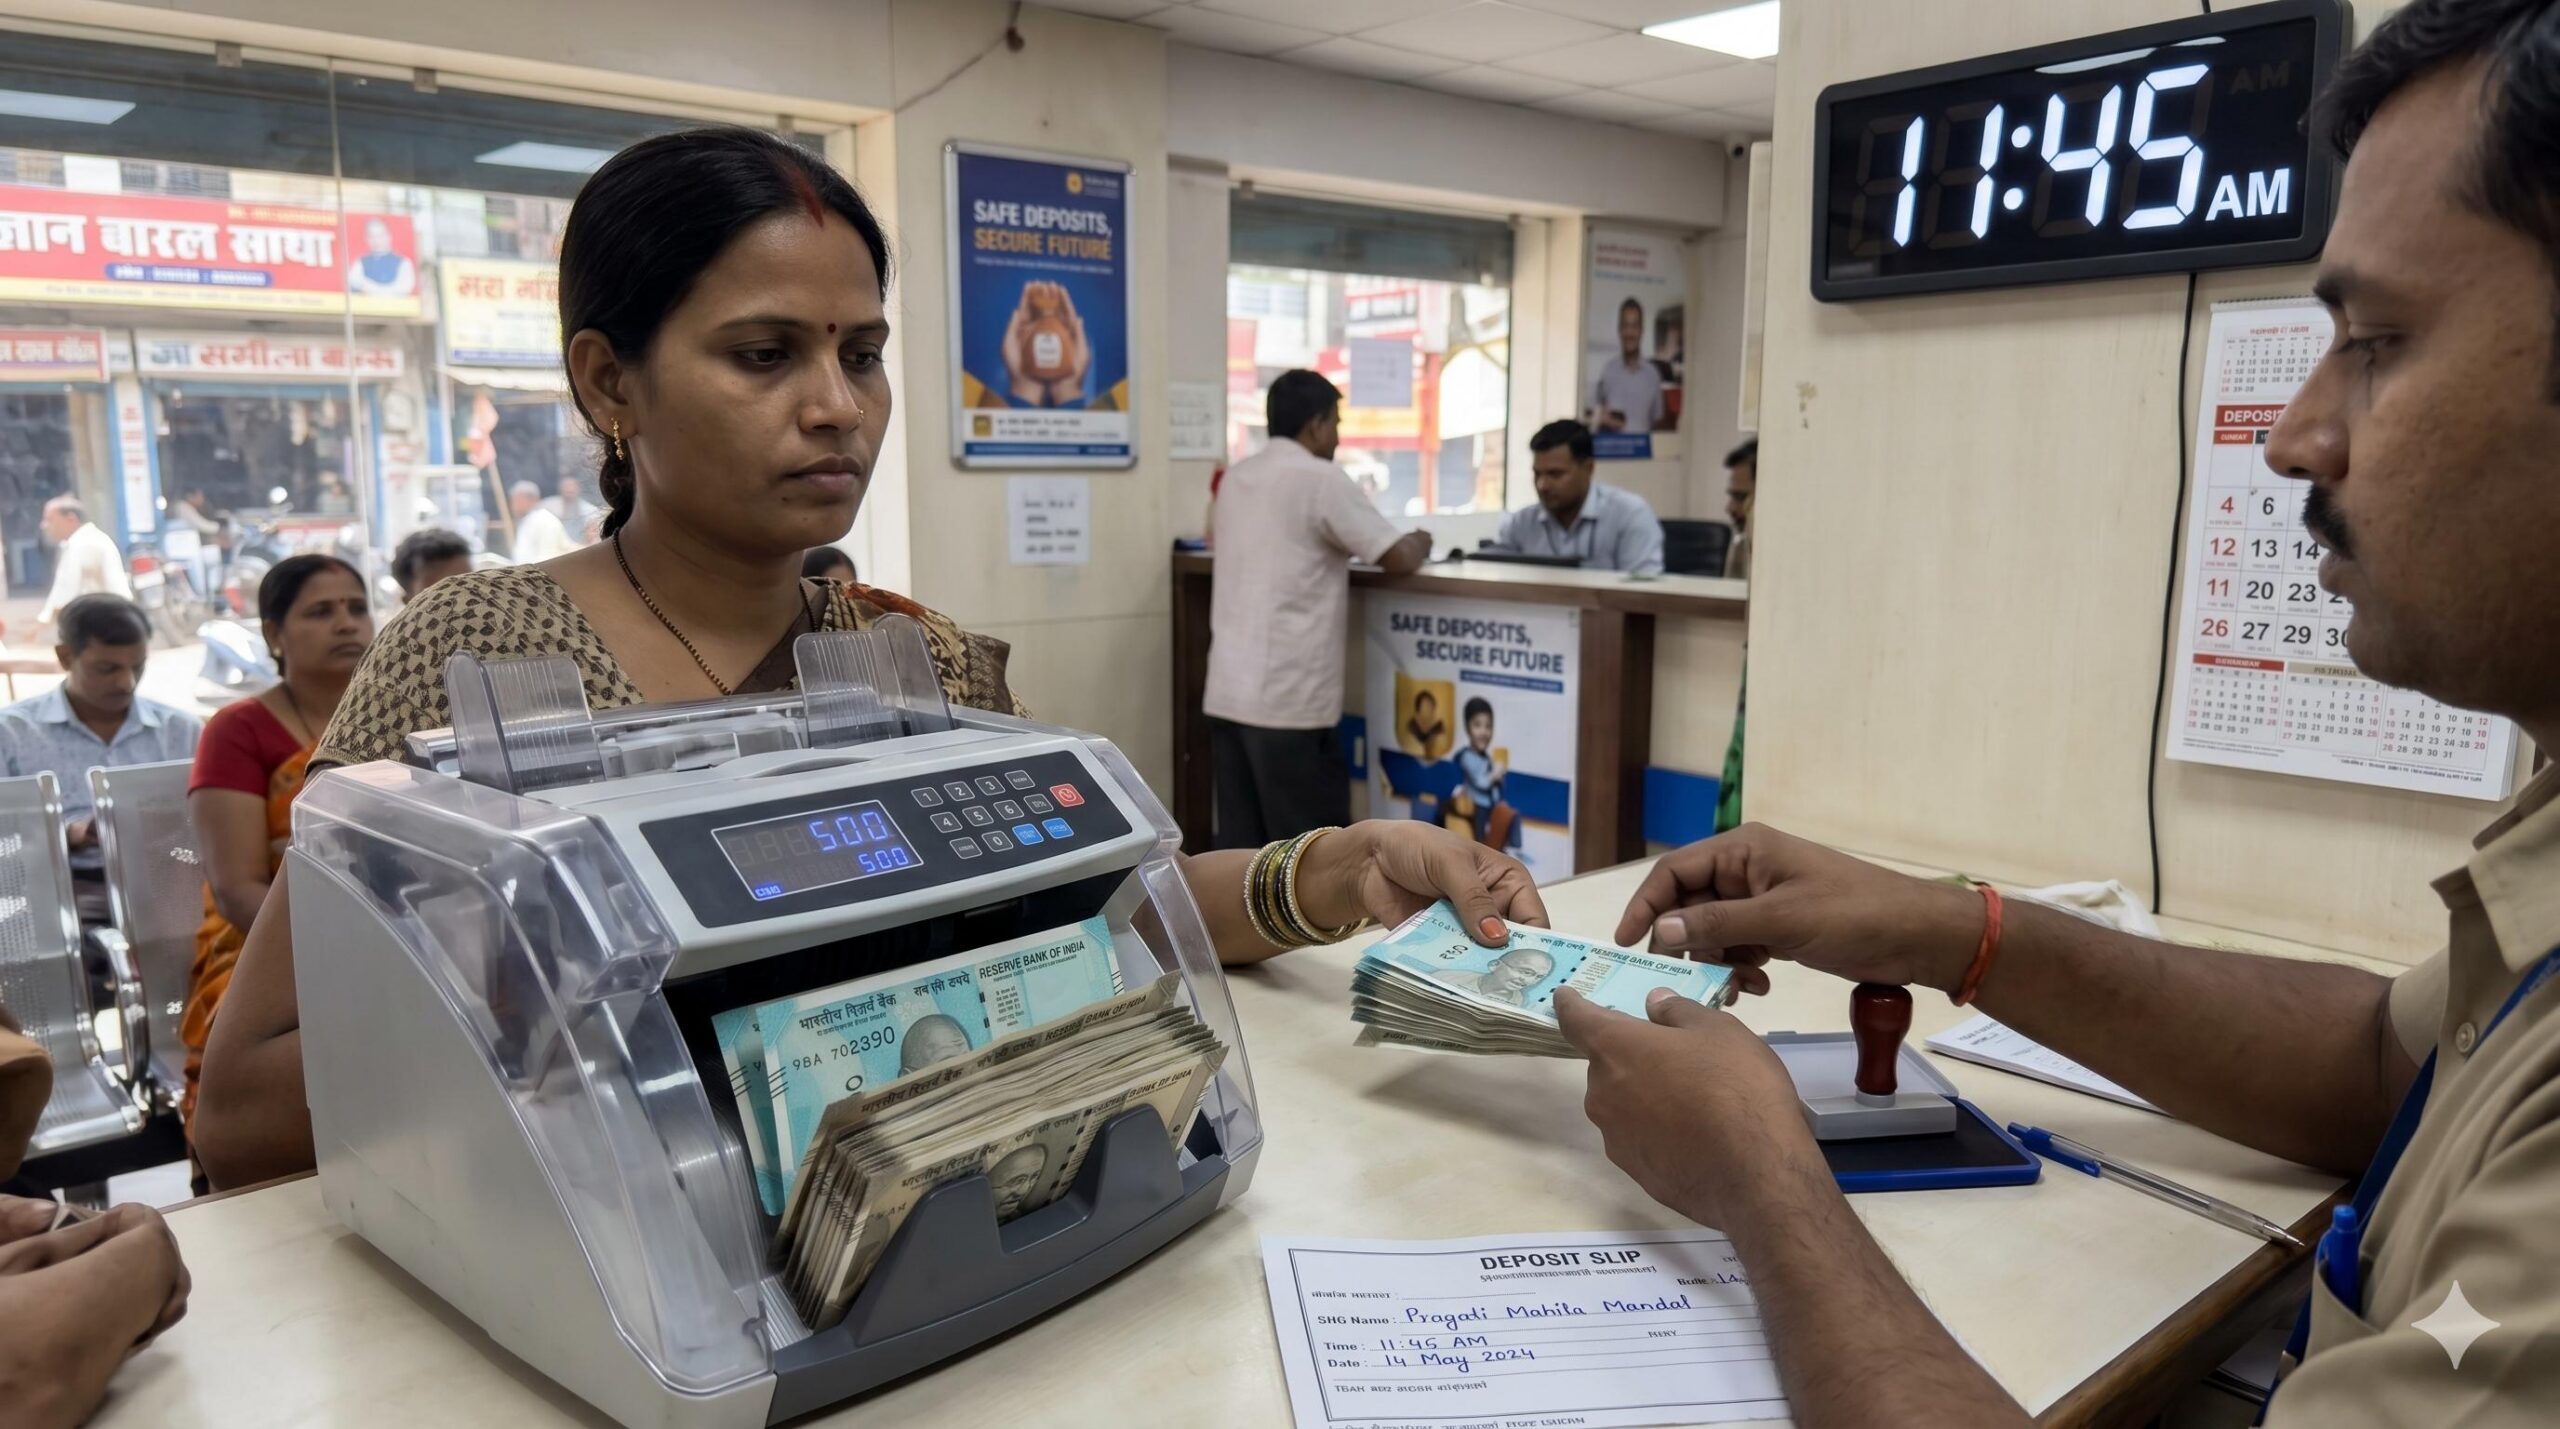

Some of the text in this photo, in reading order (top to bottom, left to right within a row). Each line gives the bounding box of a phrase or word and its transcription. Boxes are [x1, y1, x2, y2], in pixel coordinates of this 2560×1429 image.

[1893, 63, 2290, 248] 11:45 AM
[974, 199, 1112, 237] SAFE DEPOSITS,
[974, 228, 1112, 260] SECURE FUTURE
[2220, 496, 2275, 515] 4 6
[2210, 538, 2320, 559] 12 13 14
[2207, 579, 2230, 597] 11
[2246, 581, 2274, 599] 20
[2288, 584, 2316, 602] 23
[1390, 613, 1533, 647] SAFE DEPOSITS,
[2201, 618, 2228, 637] 26
[2242, 622, 2269, 640] 27
[2283, 625, 2311, 644] 29
[1416, 640, 1564, 674] SECURE FUTURE
[922, 781, 996, 802] 1 2 3
[943, 805, 1015, 827] 4 5 6
[809, 811, 889, 851] 500
[992, 836, 1003, 846] 0
[859, 847, 909, 873] 500
[979, 957, 1022, 979] RESERVE
[1023, 950, 1049, 966] BANK
[1049, 947, 1061, 959] OF
[792, 1026, 896, 1071] 9BA 702390
[1480, 1250, 1641, 1270] DEPOSIT SLIP
[1317, 1316, 1347, 1325] SHG
[1406, 1294, 1692, 1331] Pragati Mahila Mandal
[1324, 1342, 1357, 1351] Time
[1380, 1336, 1488, 1351] 11:45 AM
[1385, 1348, 1535, 1373] 14 May 2024
